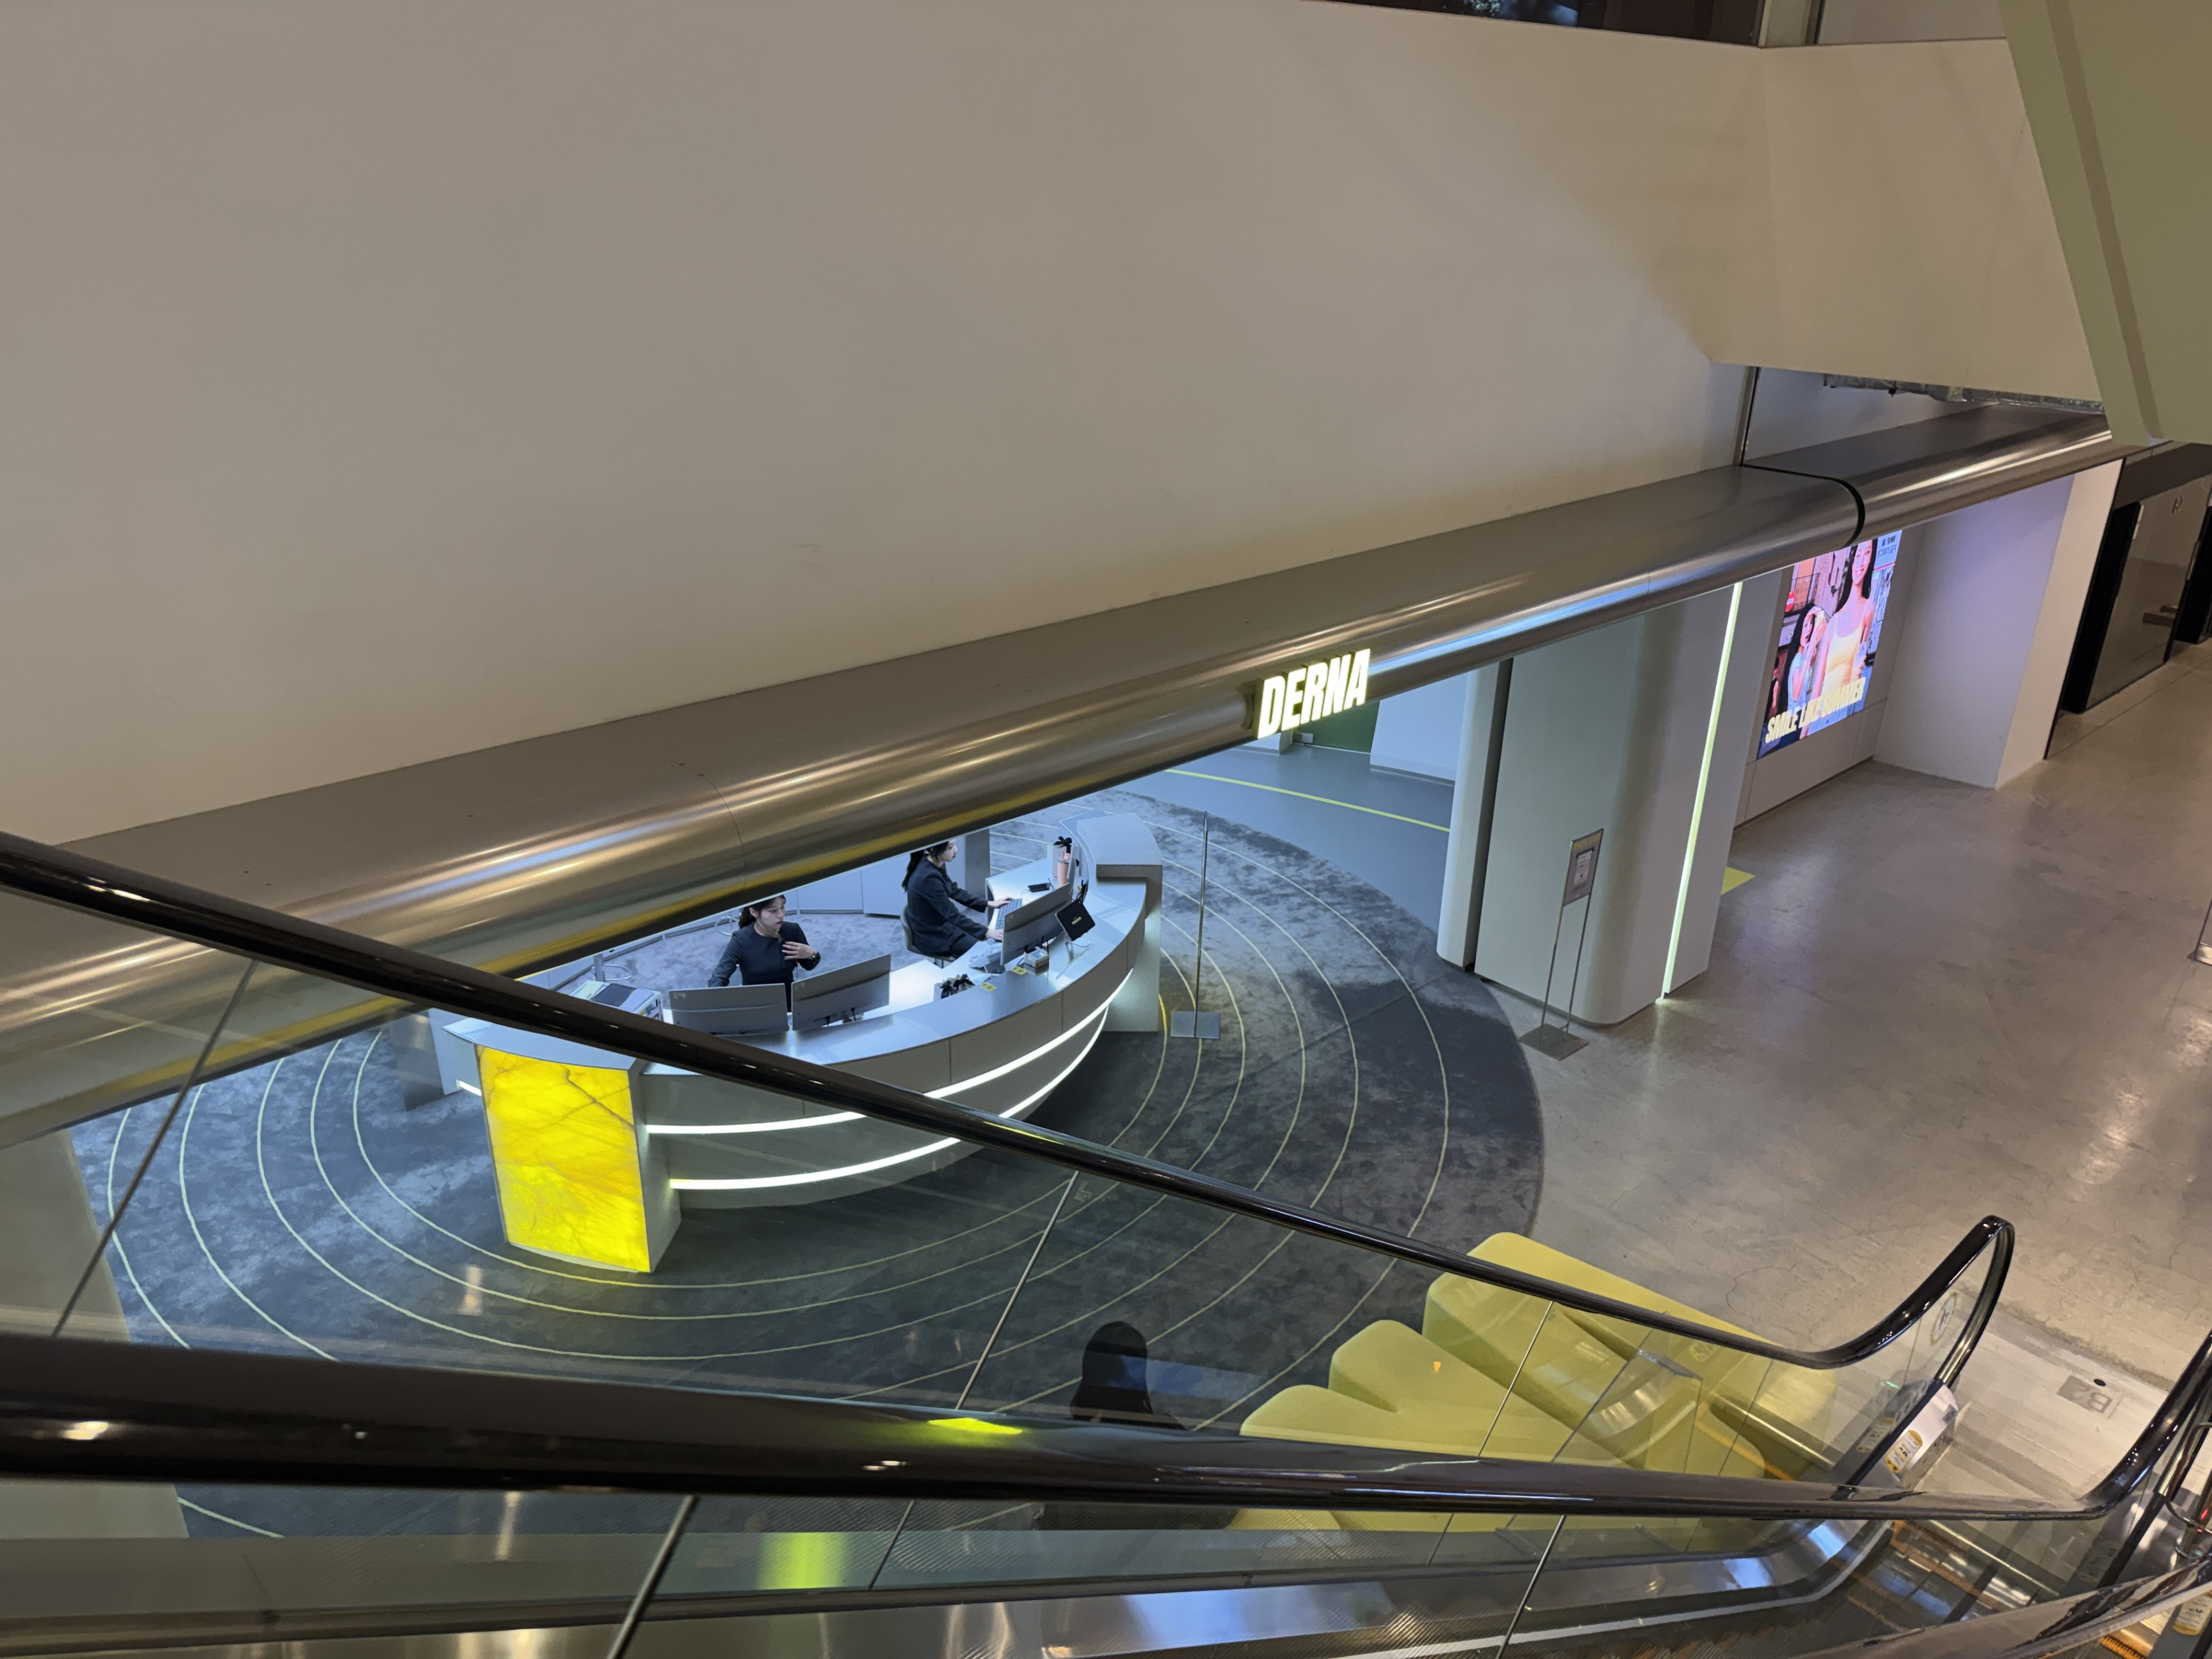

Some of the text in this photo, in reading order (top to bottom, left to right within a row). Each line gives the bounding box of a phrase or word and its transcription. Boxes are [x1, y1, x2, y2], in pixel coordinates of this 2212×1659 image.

[1257, 648, 1371, 740] DERNA
[1765, 677, 1866, 743] SMILE LIKE SUMMER
[2069, 1382, 2113, 1414] B2
